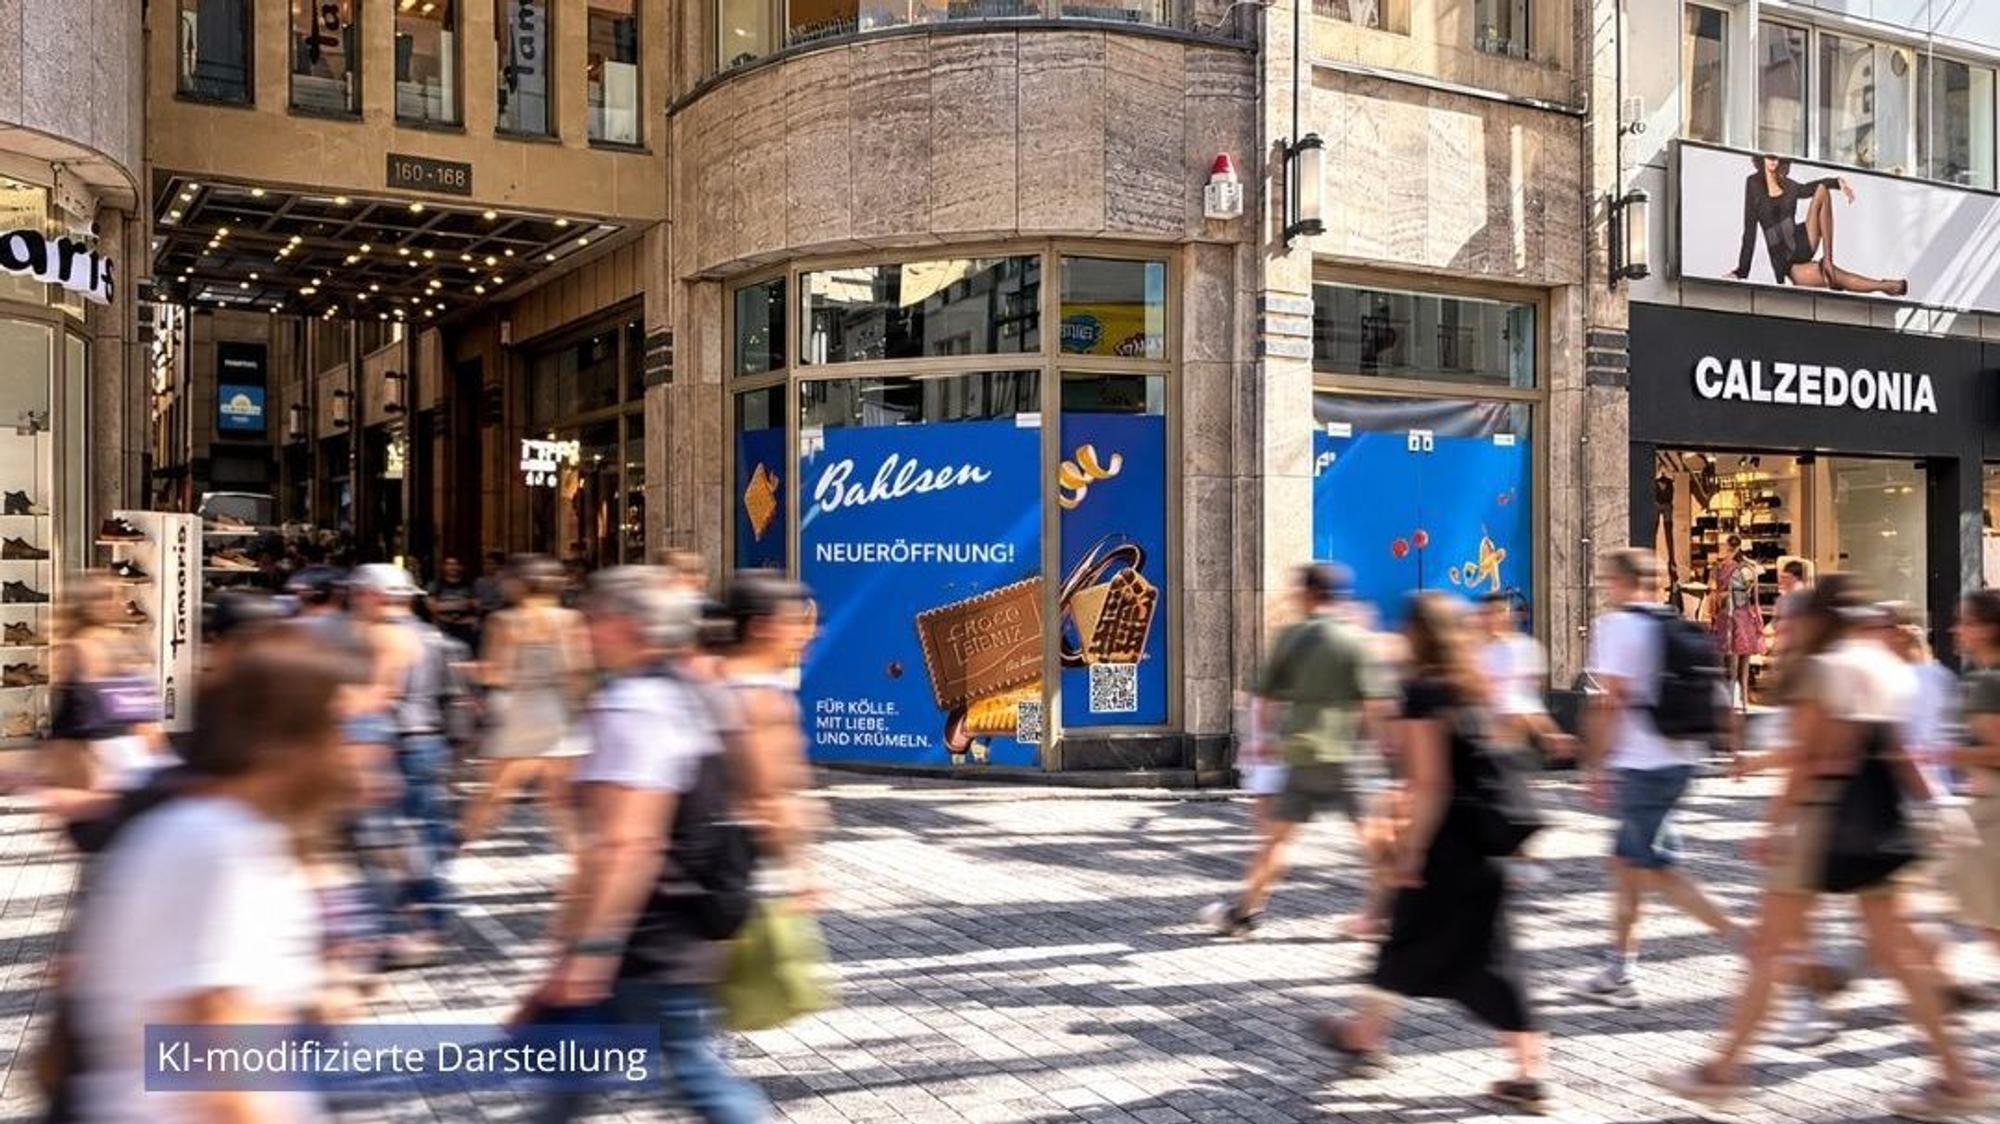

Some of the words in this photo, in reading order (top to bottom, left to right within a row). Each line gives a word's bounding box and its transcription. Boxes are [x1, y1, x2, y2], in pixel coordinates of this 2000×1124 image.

[1695, 355, 1938, 413] CALZEDONIA
[814, 452, 992, 512] Bahlsen
[816, 539, 1014, 563] NEUERÖFFNUNG!
[816, 698, 845, 714] FÜR
[848, 698, 899, 716] KÖLLE.
[816, 717, 842, 730] MIT
[846, 718, 889, 731] LIEBE.
[816, 732, 849, 745] UND
[853, 731, 932, 748] KRÜMELN.
